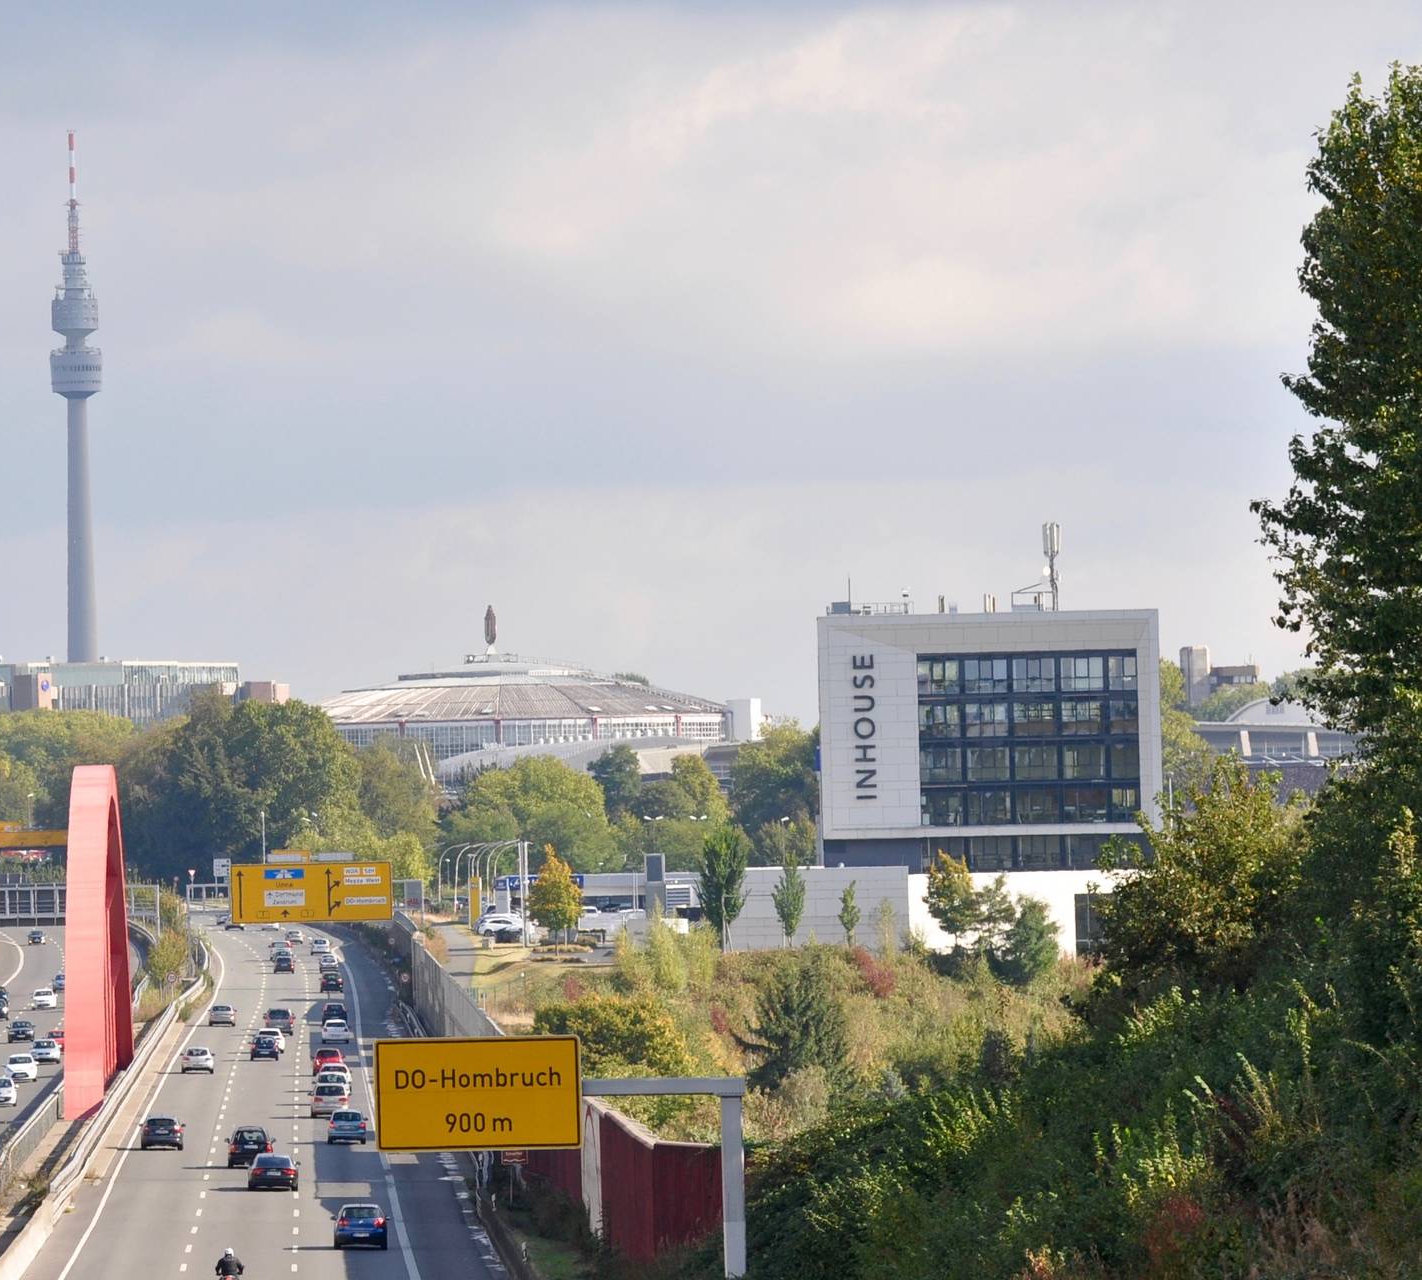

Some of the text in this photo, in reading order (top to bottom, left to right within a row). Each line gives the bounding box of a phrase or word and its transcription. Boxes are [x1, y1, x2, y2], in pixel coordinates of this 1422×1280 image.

[852, 653, 878, 800] INHOUSE
[394, 1066, 562, 1090] DO-Hombruch
[445, 1112, 513, 1133] 900 m
